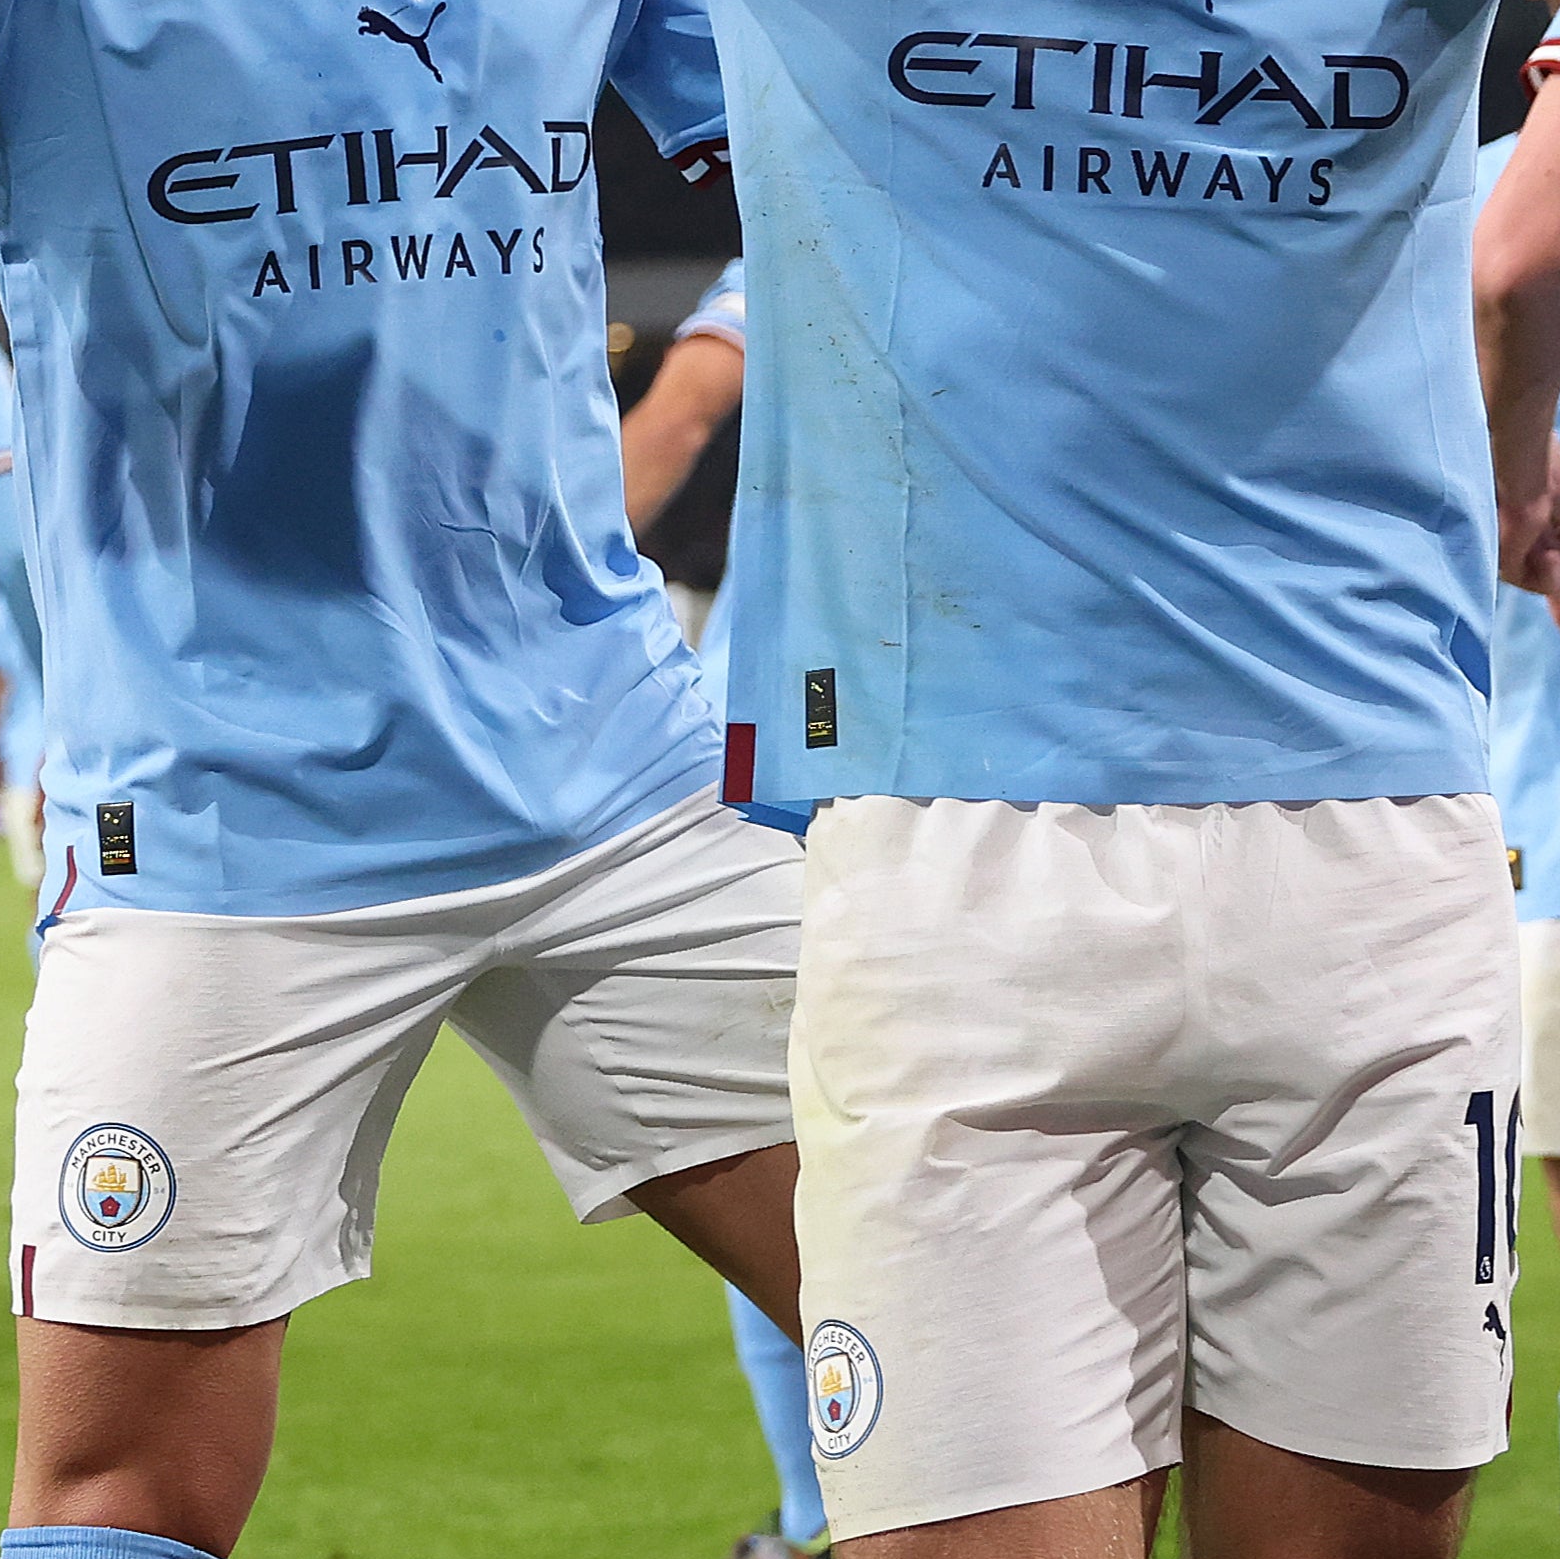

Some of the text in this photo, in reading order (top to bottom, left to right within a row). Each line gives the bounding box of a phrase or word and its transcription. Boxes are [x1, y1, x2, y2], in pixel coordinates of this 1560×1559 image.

[887, 30, 1411, 131] ETIHAD
[146, 120, 592, 225] ETIHAD
[982, 142, 1334, 206] AIRWAYS
[253, 227, 545, 298] AIRWAYS
[72, 1133, 161, 1175] MANCHESTER
[1464, 1085, 1523, 1280] 1
[92, 1230, 127, 1242] CITY
[828, 1433, 852, 1450] CITY
